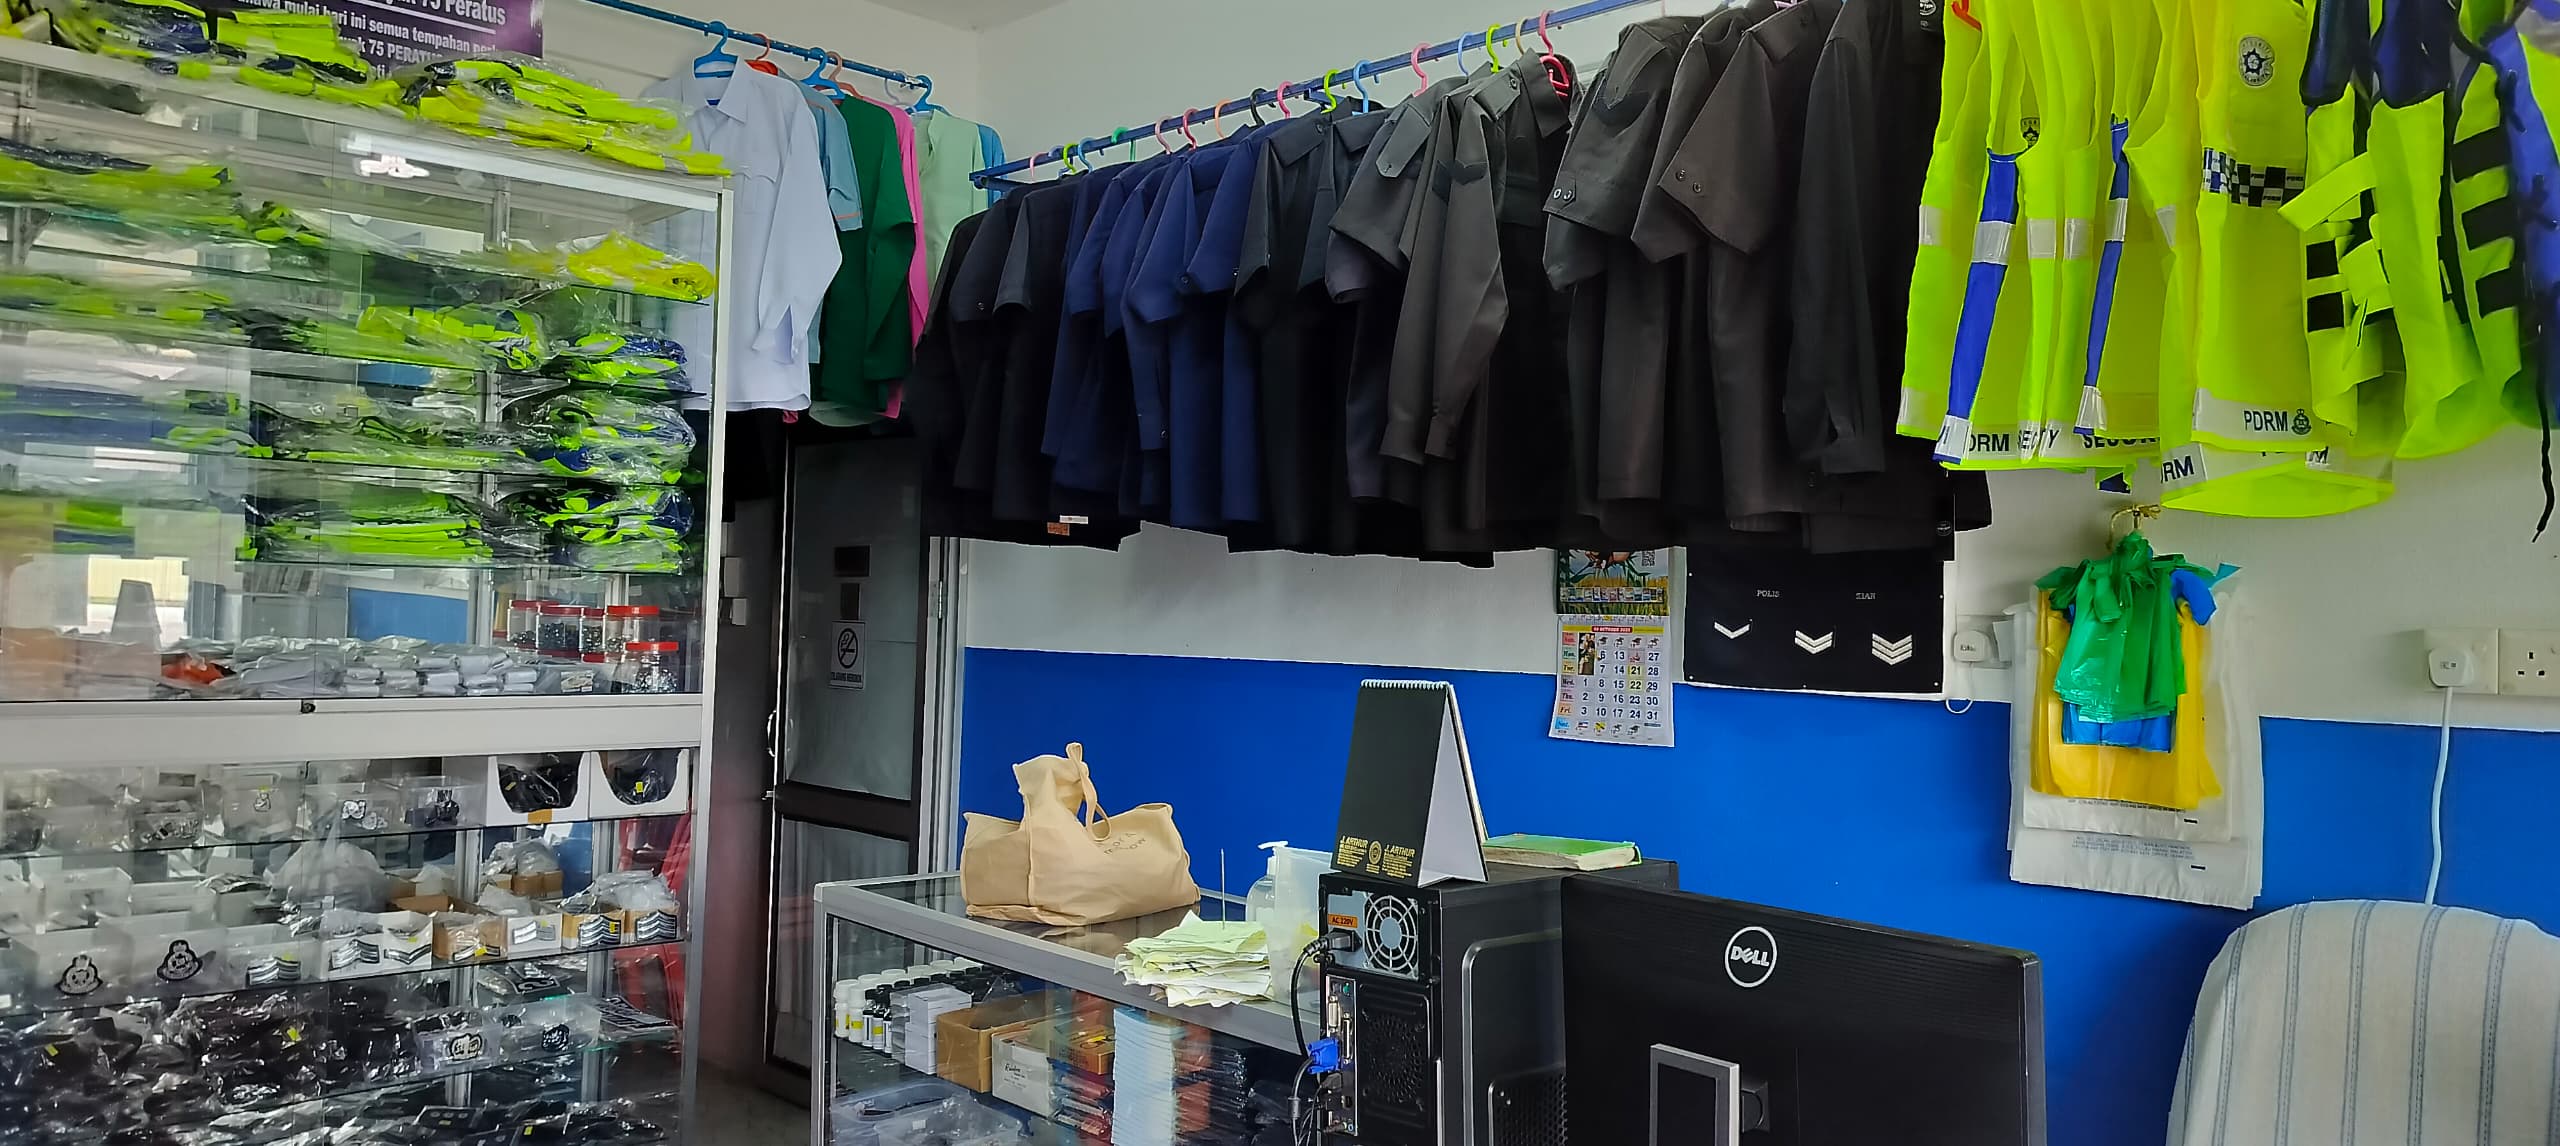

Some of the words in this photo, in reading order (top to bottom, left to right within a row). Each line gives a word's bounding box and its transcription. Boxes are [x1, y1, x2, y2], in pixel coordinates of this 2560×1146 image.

[445, 0, 506, 25] Peratus
[351, 12, 366, 30] ini
[369, 20, 409, 39] semua
[412, 27, 470, 52] tempahan
[369, 39, 384, 56] 75
[2243, 410, 2289, 432] PDRM
[1968, 433, 2010, 451] DRM
[1756, 589, 1780, 598] POLIS
[1600, 651, 1606, 660] 6
[1614, 651, 1625, 660] 13
[1648, 652, 1660, 661] 27
[1599, 665, 1606, 674] 7
[1614, 665, 1625, 674] 14
[1631, 665, 1641, 675] 21
[1647, 667, 1659, 676] 28
[1583, 678, 1588, 687] 1
[1598, 679, 1605, 688] 8
[1613, 680, 1625, 689] 15
[1630, 681, 1642, 690] 22
[1647, 681, 1658, 691] 29
[1582, 692, 1589, 701] 2
[1598, 693, 1605, 702] 9
[1613, 694, 1624, 704] 16
[1629, 695, 1641, 704] 23
[1646, 697, 1658, 706] 30
[1581, 706, 1588, 715] 3
[1596, 708, 1607, 717] 10
[1612, 709, 1623, 718] 17
[1629, 710, 1641, 719] 24
[1646, 711, 1658, 721] 31
[1346, 837, 1368, 848] ARTHUR
[1390, 846, 1415, 857] ARTHUR
[1731, 945, 1769, 967] DELL
